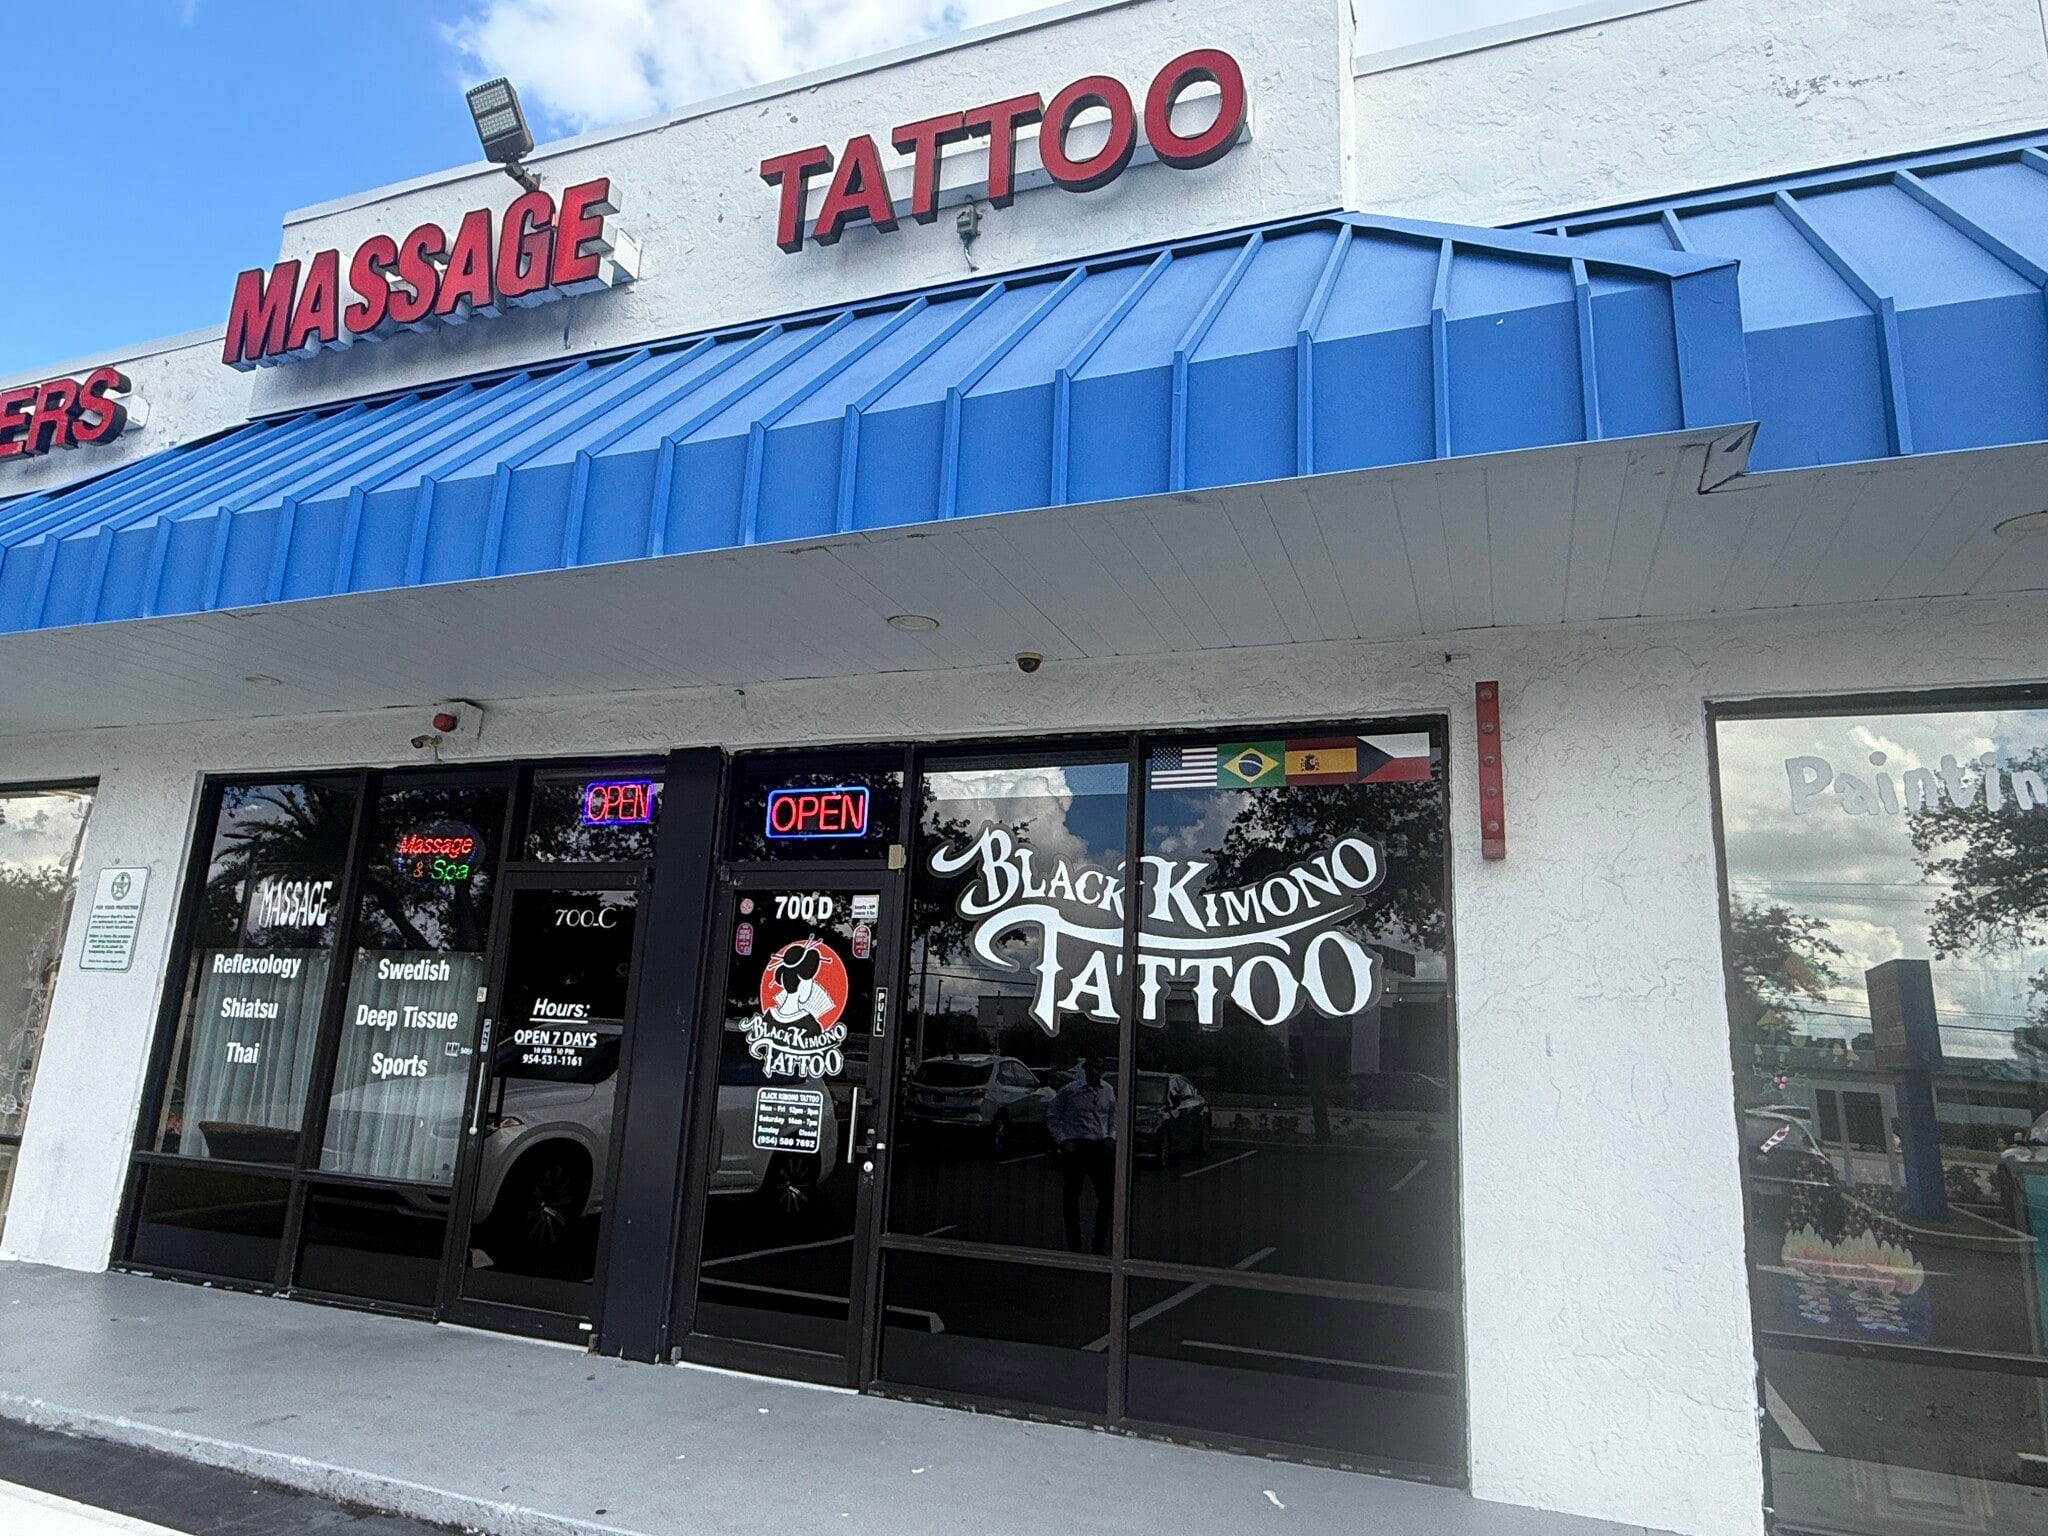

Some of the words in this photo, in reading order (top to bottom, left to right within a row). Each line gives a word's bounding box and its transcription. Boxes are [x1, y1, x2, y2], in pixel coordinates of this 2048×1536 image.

[760, 48, 1247, 252] TATTOO
[222, 177, 613, 369] MASSAGE
[0, 367, 126, 459] ERS
[587, 784, 651, 820] OPEN
[772, 794, 865, 832] OPEN
[398, 833, 474, 859] Massage
[413, 861, 424, 878] &
[430, 859, 469, 885] Spa
[931, 826, 1127, 915] BLACK
[1119, 838, 1378, 932] KIMONO
[259, 880, 333, 930] MASSAGE
[212, 953, 302, 979] Reflexology
[377, 958, 450, 981] Swedish
[974, 903, 1375, 1031] TATTOO
[220, 997, 279, 1019] Shiatsu
[355, 1004, 398, 1032] Deep
[403, 1006, 459, 1030] Tissue
[532, 998, 591, 1018] Hours:
[876, 992, 885, 1032] PULL
[514, 1029, 551, 1045] OPEN
[552, 1031, 561, 1045] 7
[562, 1032, 598, 1047] DAYS
[740, 1015, 792, 1045] BLACK
[787, 1024, 845, 1049] KIMONO
[226, 1042, 260, 1064] Thai
[371, 1052, 428, 1079] Sports
[522, 1053, 583, 1067] 954-531-1161
[751, 1038, 842, 1078] TATTOO
